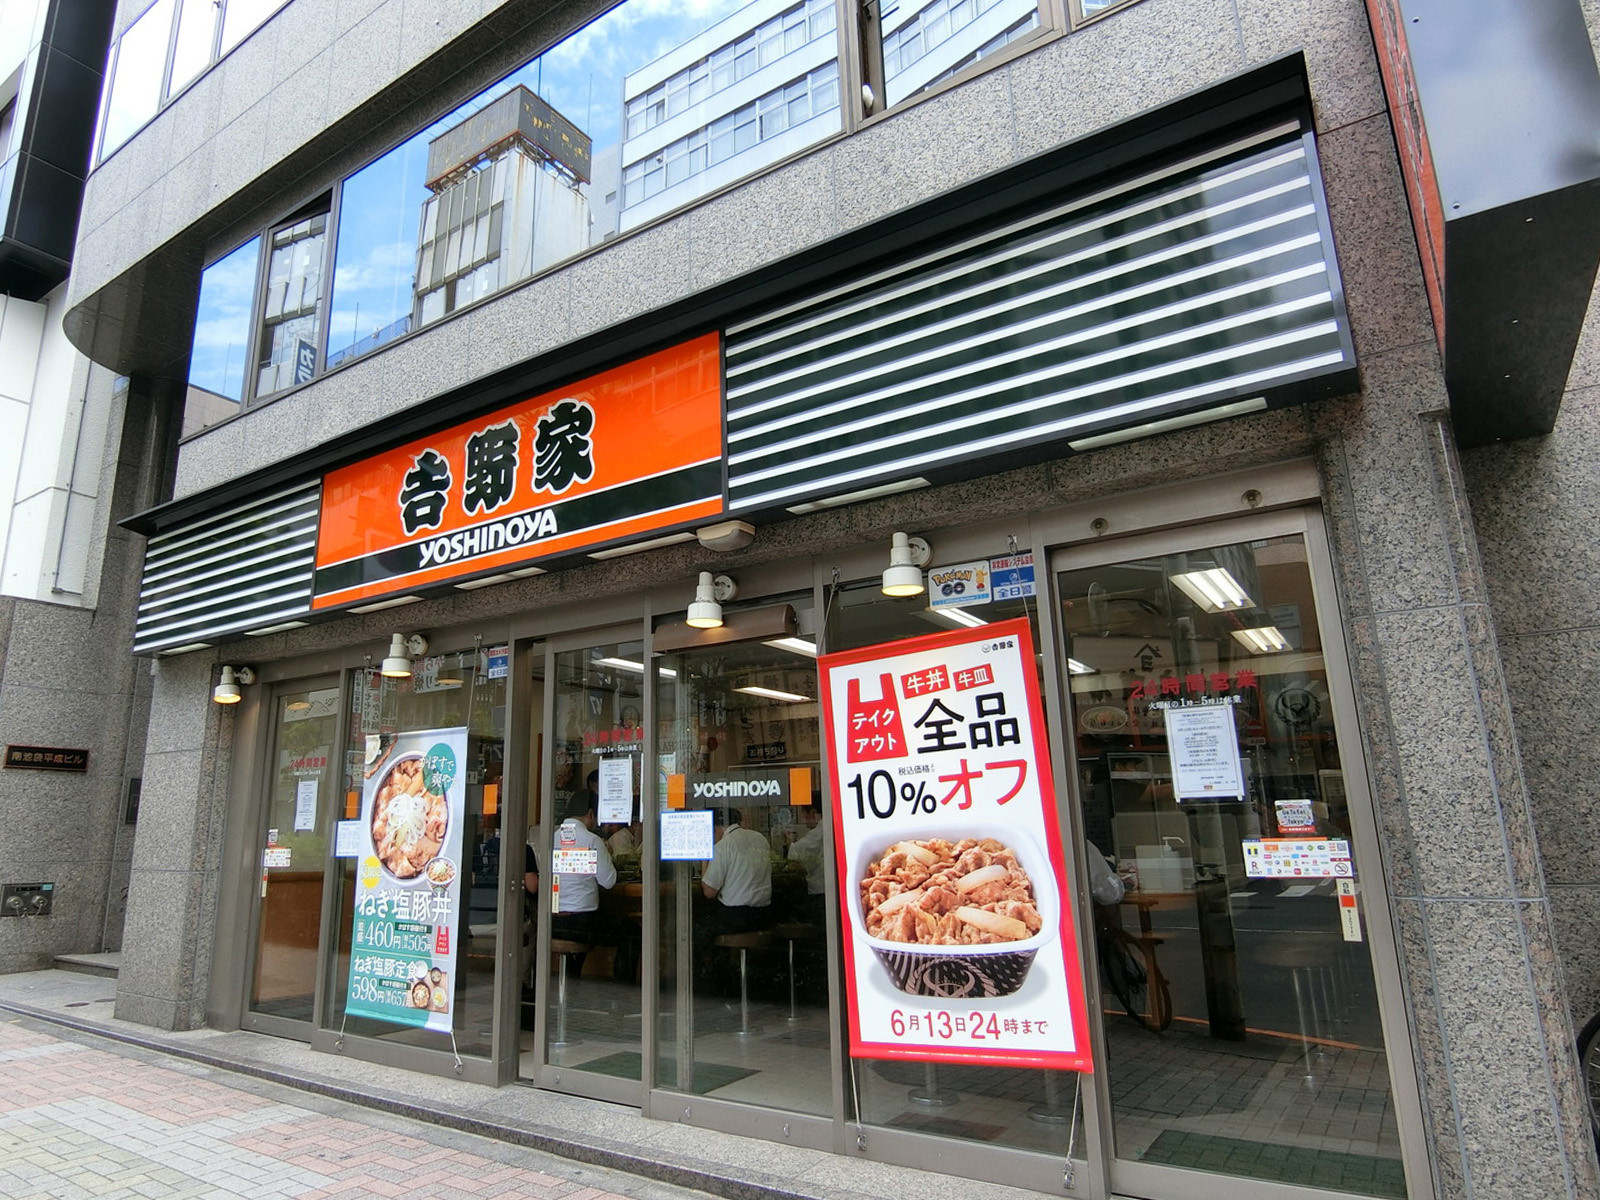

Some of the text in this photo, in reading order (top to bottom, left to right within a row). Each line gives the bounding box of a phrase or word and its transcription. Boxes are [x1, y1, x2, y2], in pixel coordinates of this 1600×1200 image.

[399, 398, 596, 536] 吉野家
[418, 508, 558, 567] YOSHINOYA
[941, 582, 966, 597] GO
[992, 640, 1014, 652] 吉野家
[906, 667, 990, 694] 牛丼 牛皿
[1130, 669, 1258, 699] 24時間営業
[852, 708, 895, 731] テイク
[913, 691, 1021, 754] 全品
[854, 732, 897, 754] アウト
[693, 780, 781, 798] YOSHINOYA
[358, 888, 452, 924] ねぎ塩豚丼
[354, 955, 418, 980] ねぎ塩豚定食
[890, 1009, 1049, 1040] 6月13日24時まで
